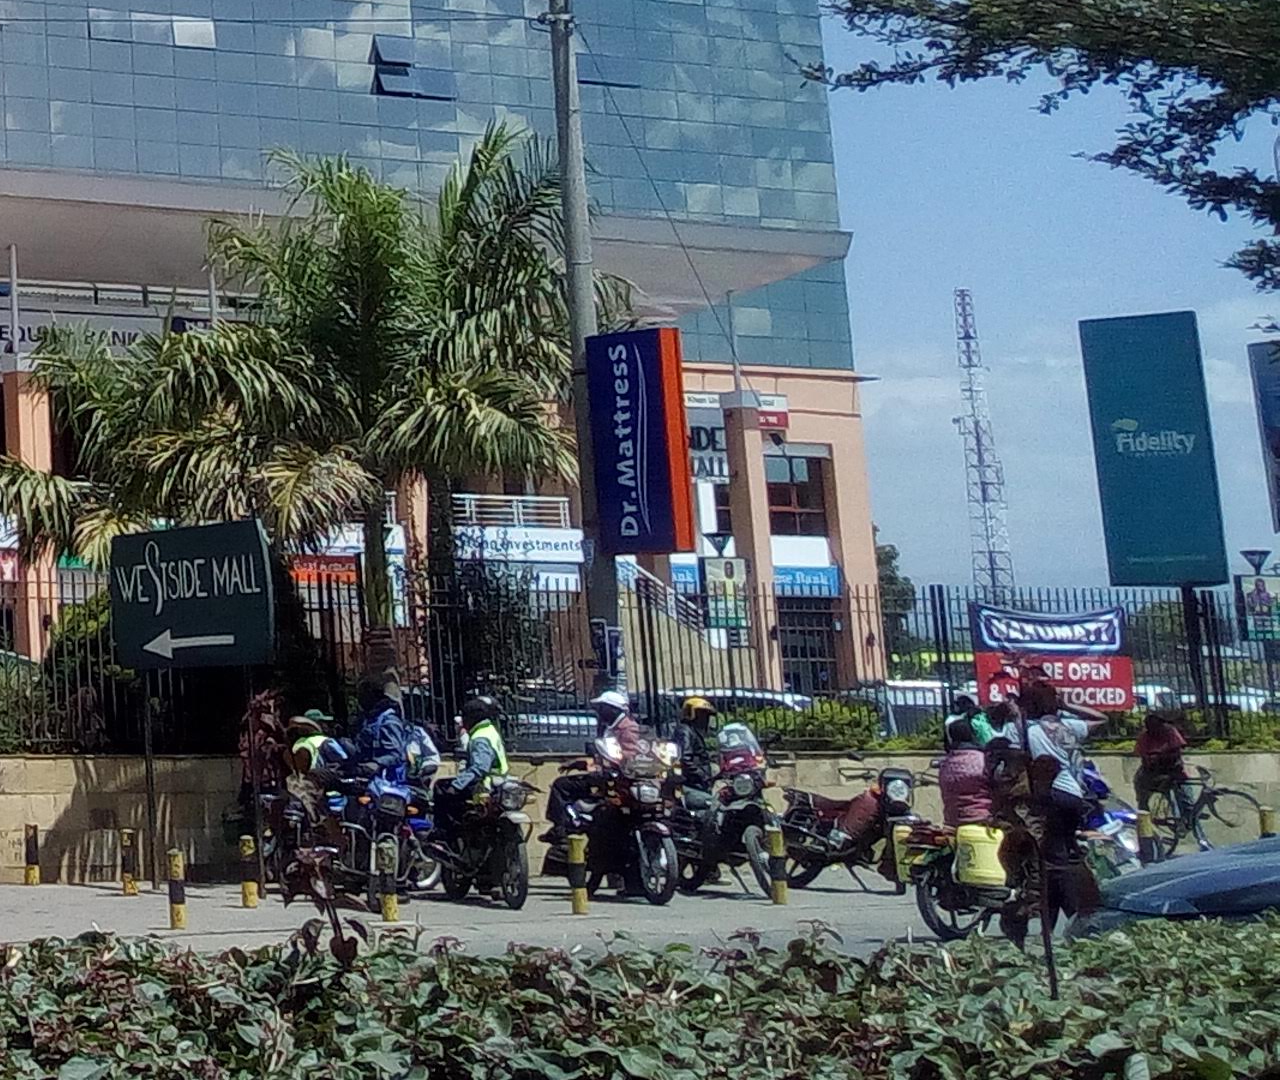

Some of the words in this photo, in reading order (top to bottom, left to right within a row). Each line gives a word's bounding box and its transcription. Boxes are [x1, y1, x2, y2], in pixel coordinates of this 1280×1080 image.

[1115, 431, 1196, 454] Fidelity
[115, 541, 209, 616] WESTSIDE
[211, 553, 262, 597] MALL
[1042, 662, 1064, 680] RE
[1068, 662, 1112, 681] OPEN
